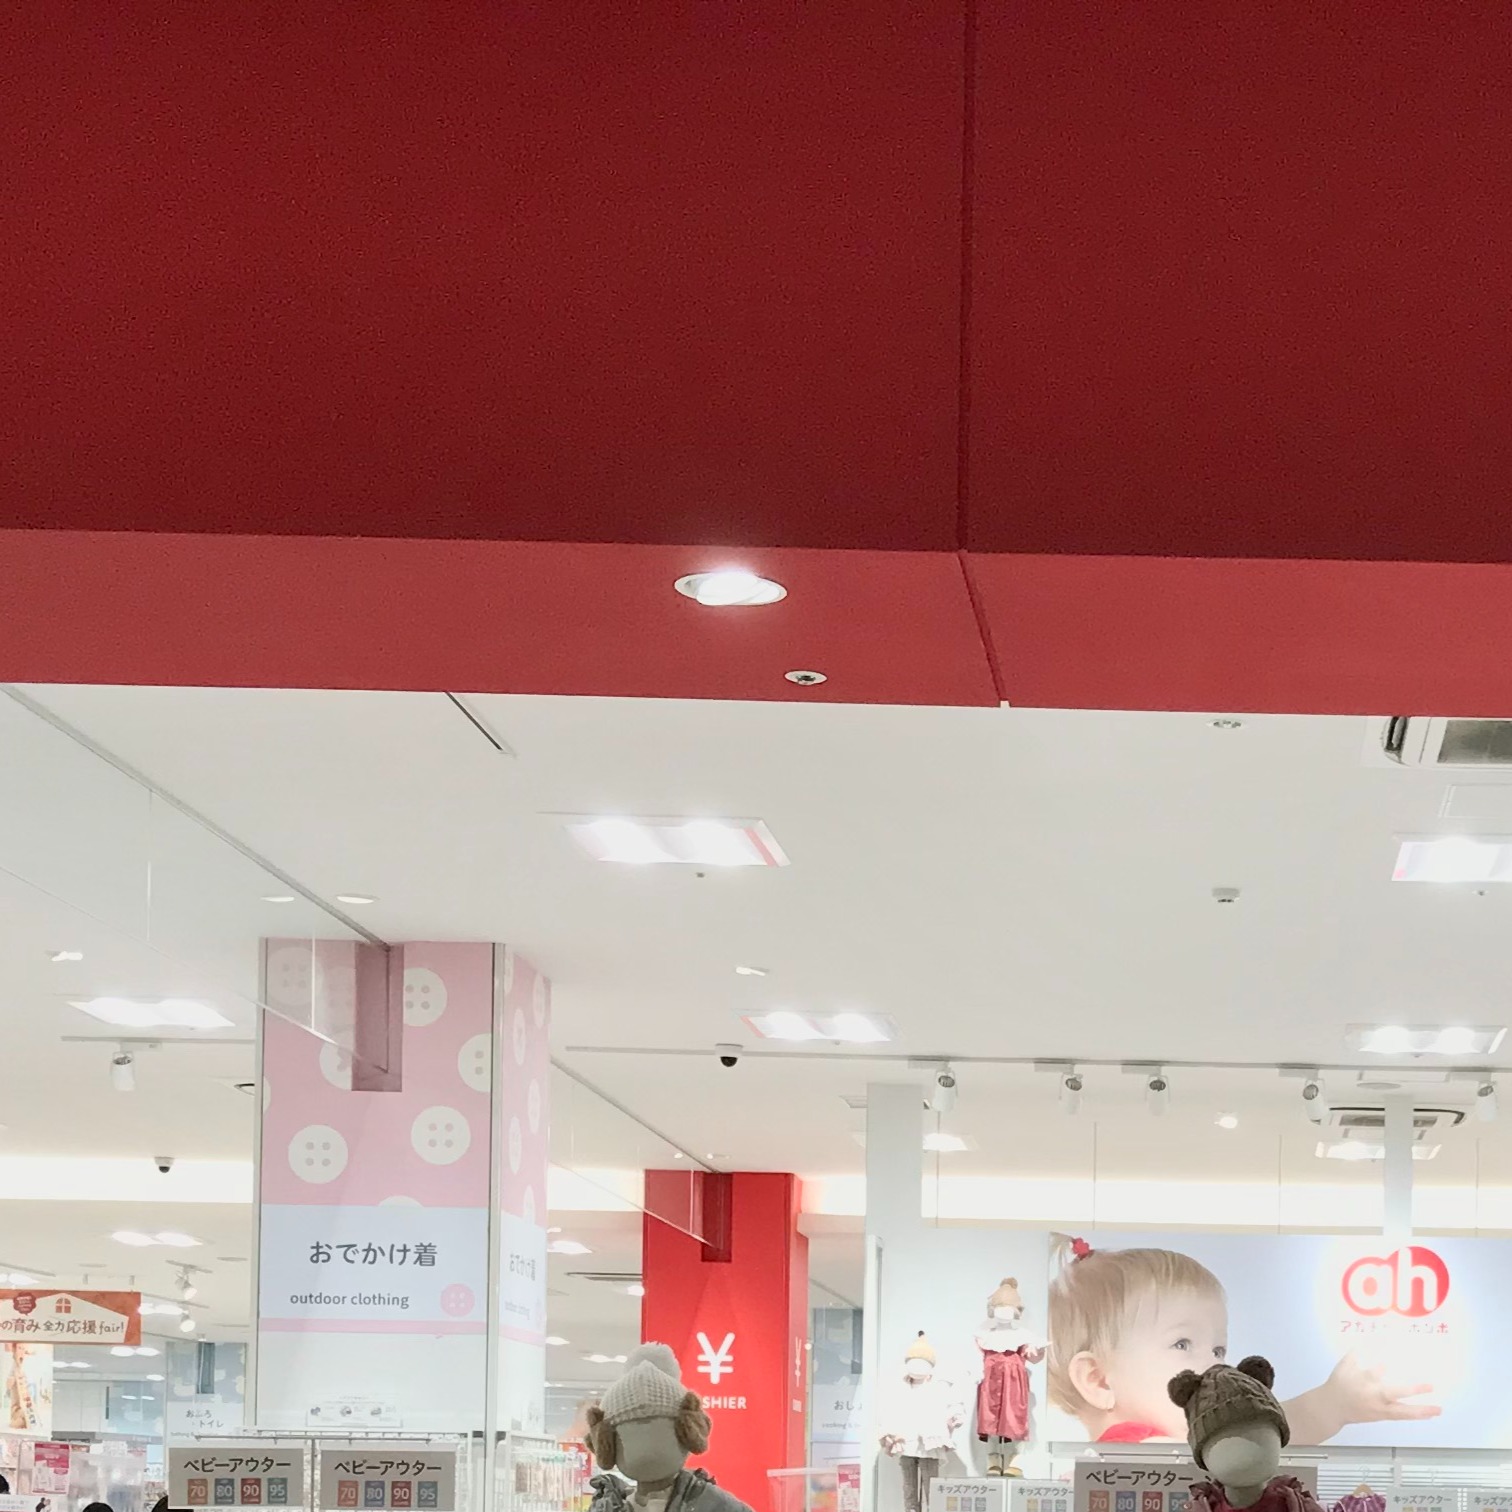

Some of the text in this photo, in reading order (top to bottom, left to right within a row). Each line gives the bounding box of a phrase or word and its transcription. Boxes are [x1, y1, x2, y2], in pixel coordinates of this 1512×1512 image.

[309, 1241, 438, 1267] おでかけ着
[290, 1291, 410, 1310] outdoor clothing
[701, 1396, 747, 1410] SHIER
[183, 1456, 292, 1473] ベビーアウター
[334, 1460, 442, 1477] ベビーアウター
[1086, 1468, 1194, 1486] ベビーアウター
[189, 1484, 286, 1497] 70 80 90 95
[340, 1487, 436, 1499] 70 80 90 95
[937, 1484, 997, 1495] キッズアウター
[1091, 1499, 1107, 1510] 70
[1117, 1499, 1134, 1510] 80
[1144, 1499, 1160, 1510] 90
